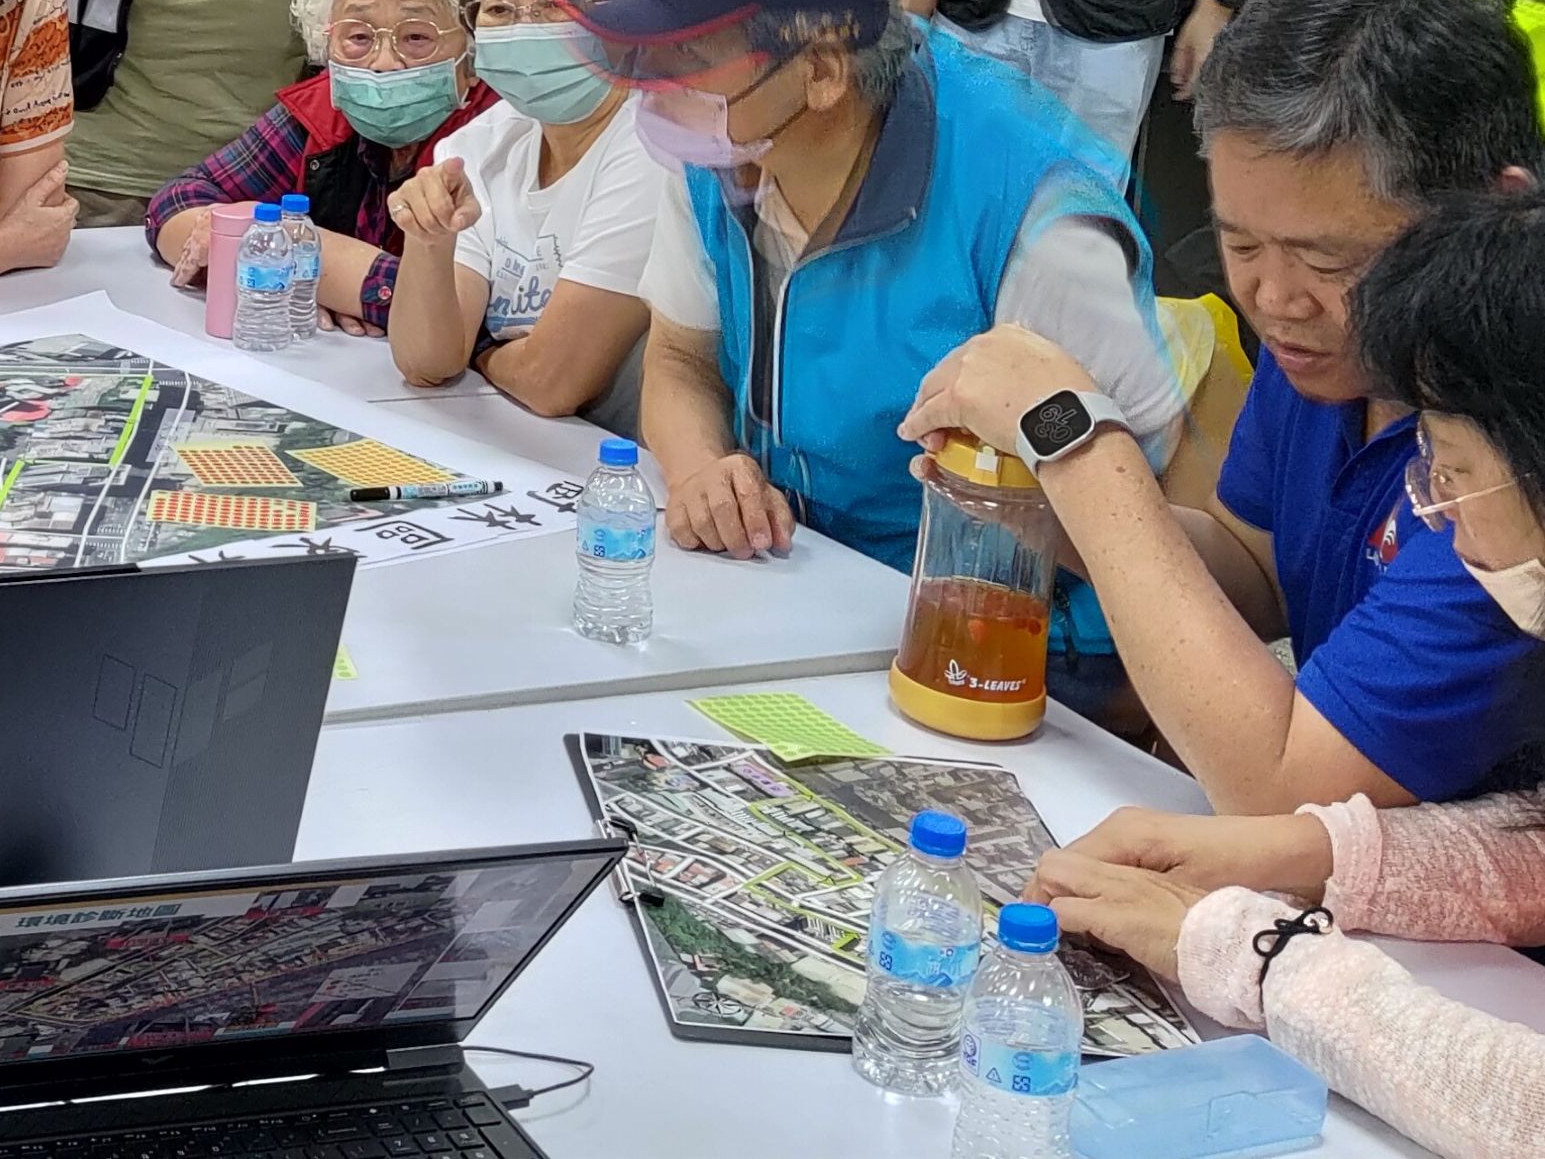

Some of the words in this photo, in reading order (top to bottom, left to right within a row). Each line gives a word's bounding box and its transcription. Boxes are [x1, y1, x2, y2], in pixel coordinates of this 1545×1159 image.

[968, 676, 1021, 691] 3-LEAVES
[16, 903, 184, 928] 環境診斷地圖
